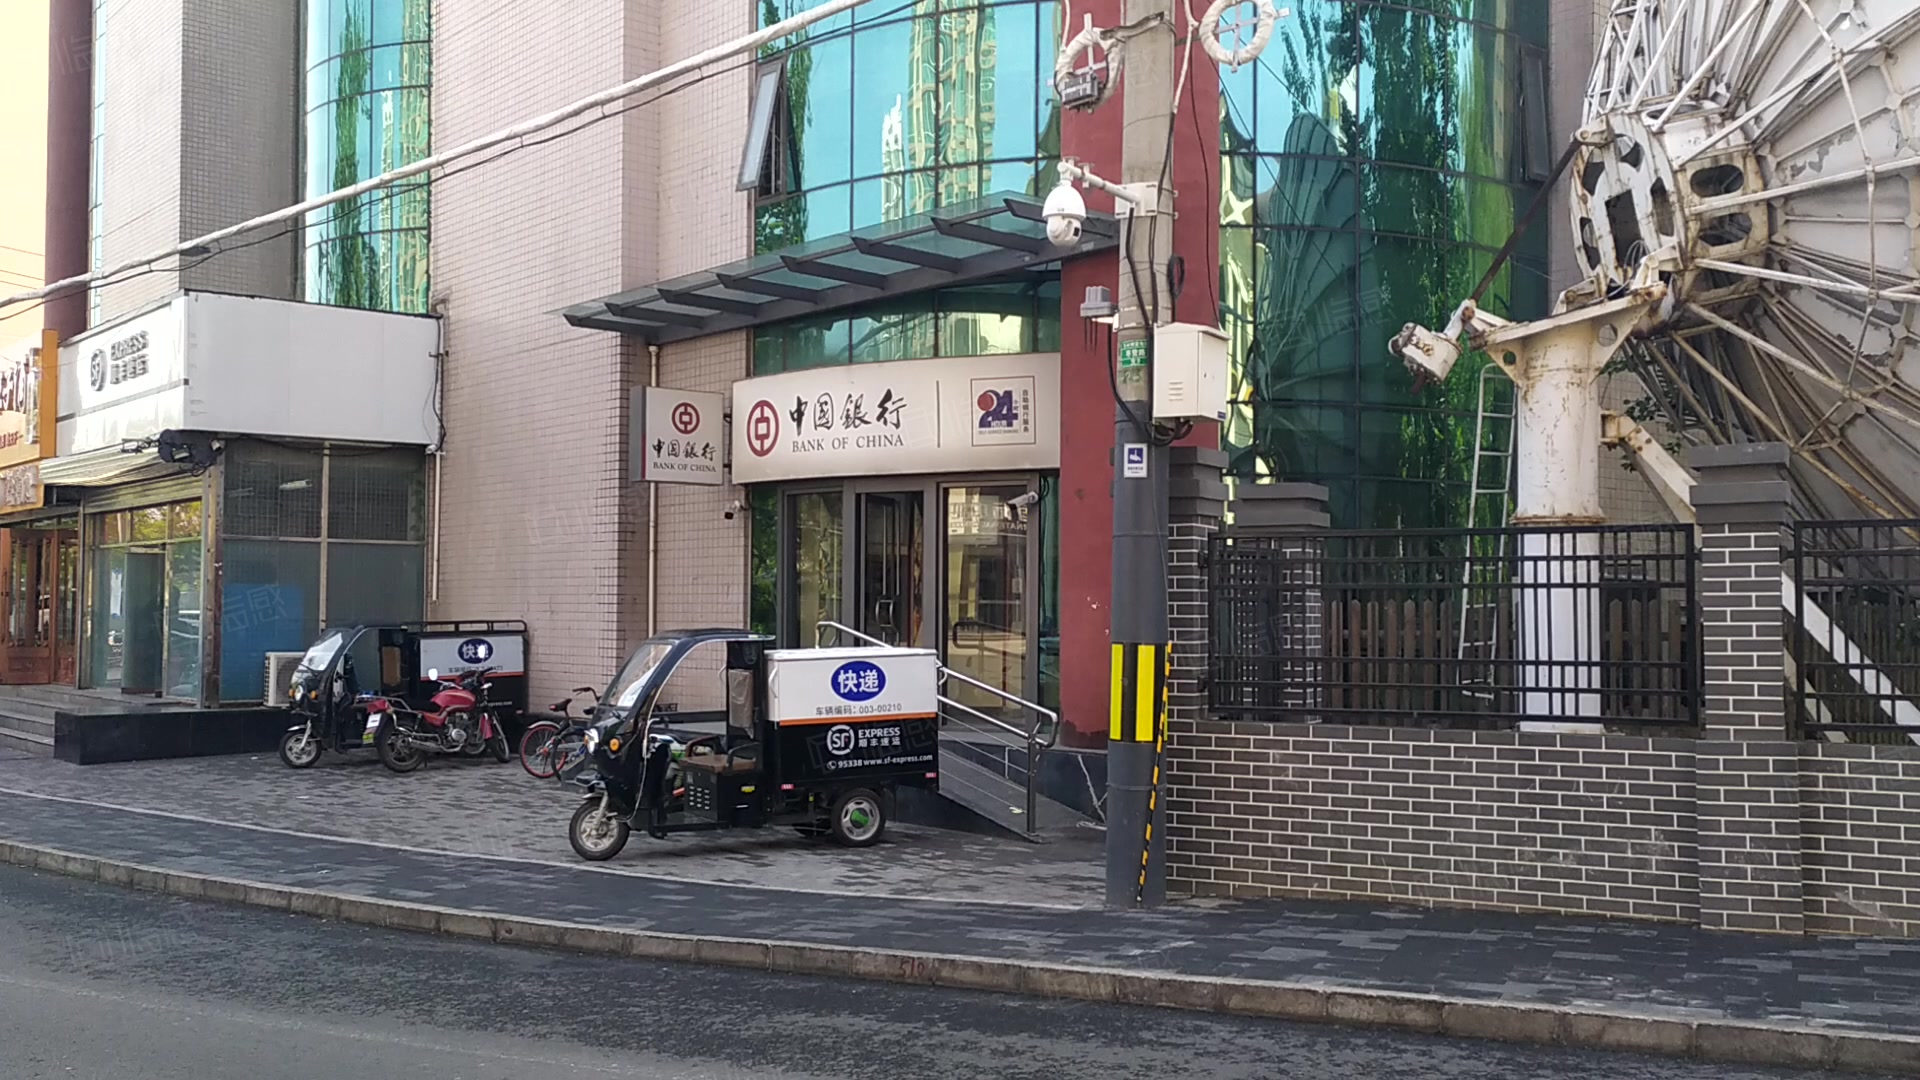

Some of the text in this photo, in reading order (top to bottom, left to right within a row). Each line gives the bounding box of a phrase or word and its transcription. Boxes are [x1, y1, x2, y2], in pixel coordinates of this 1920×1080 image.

[977, 389, 1019, 429] 24
[792, 434, 904, 453] BANK OF CHINA
[653, 461, 717, 473] BANK OF CHINA
[838, 668, 879, 694] 快递
[858, 727, 901, 738] EXPRESS
[838, 754, 933, 769] 95338 www.sf-express.com
